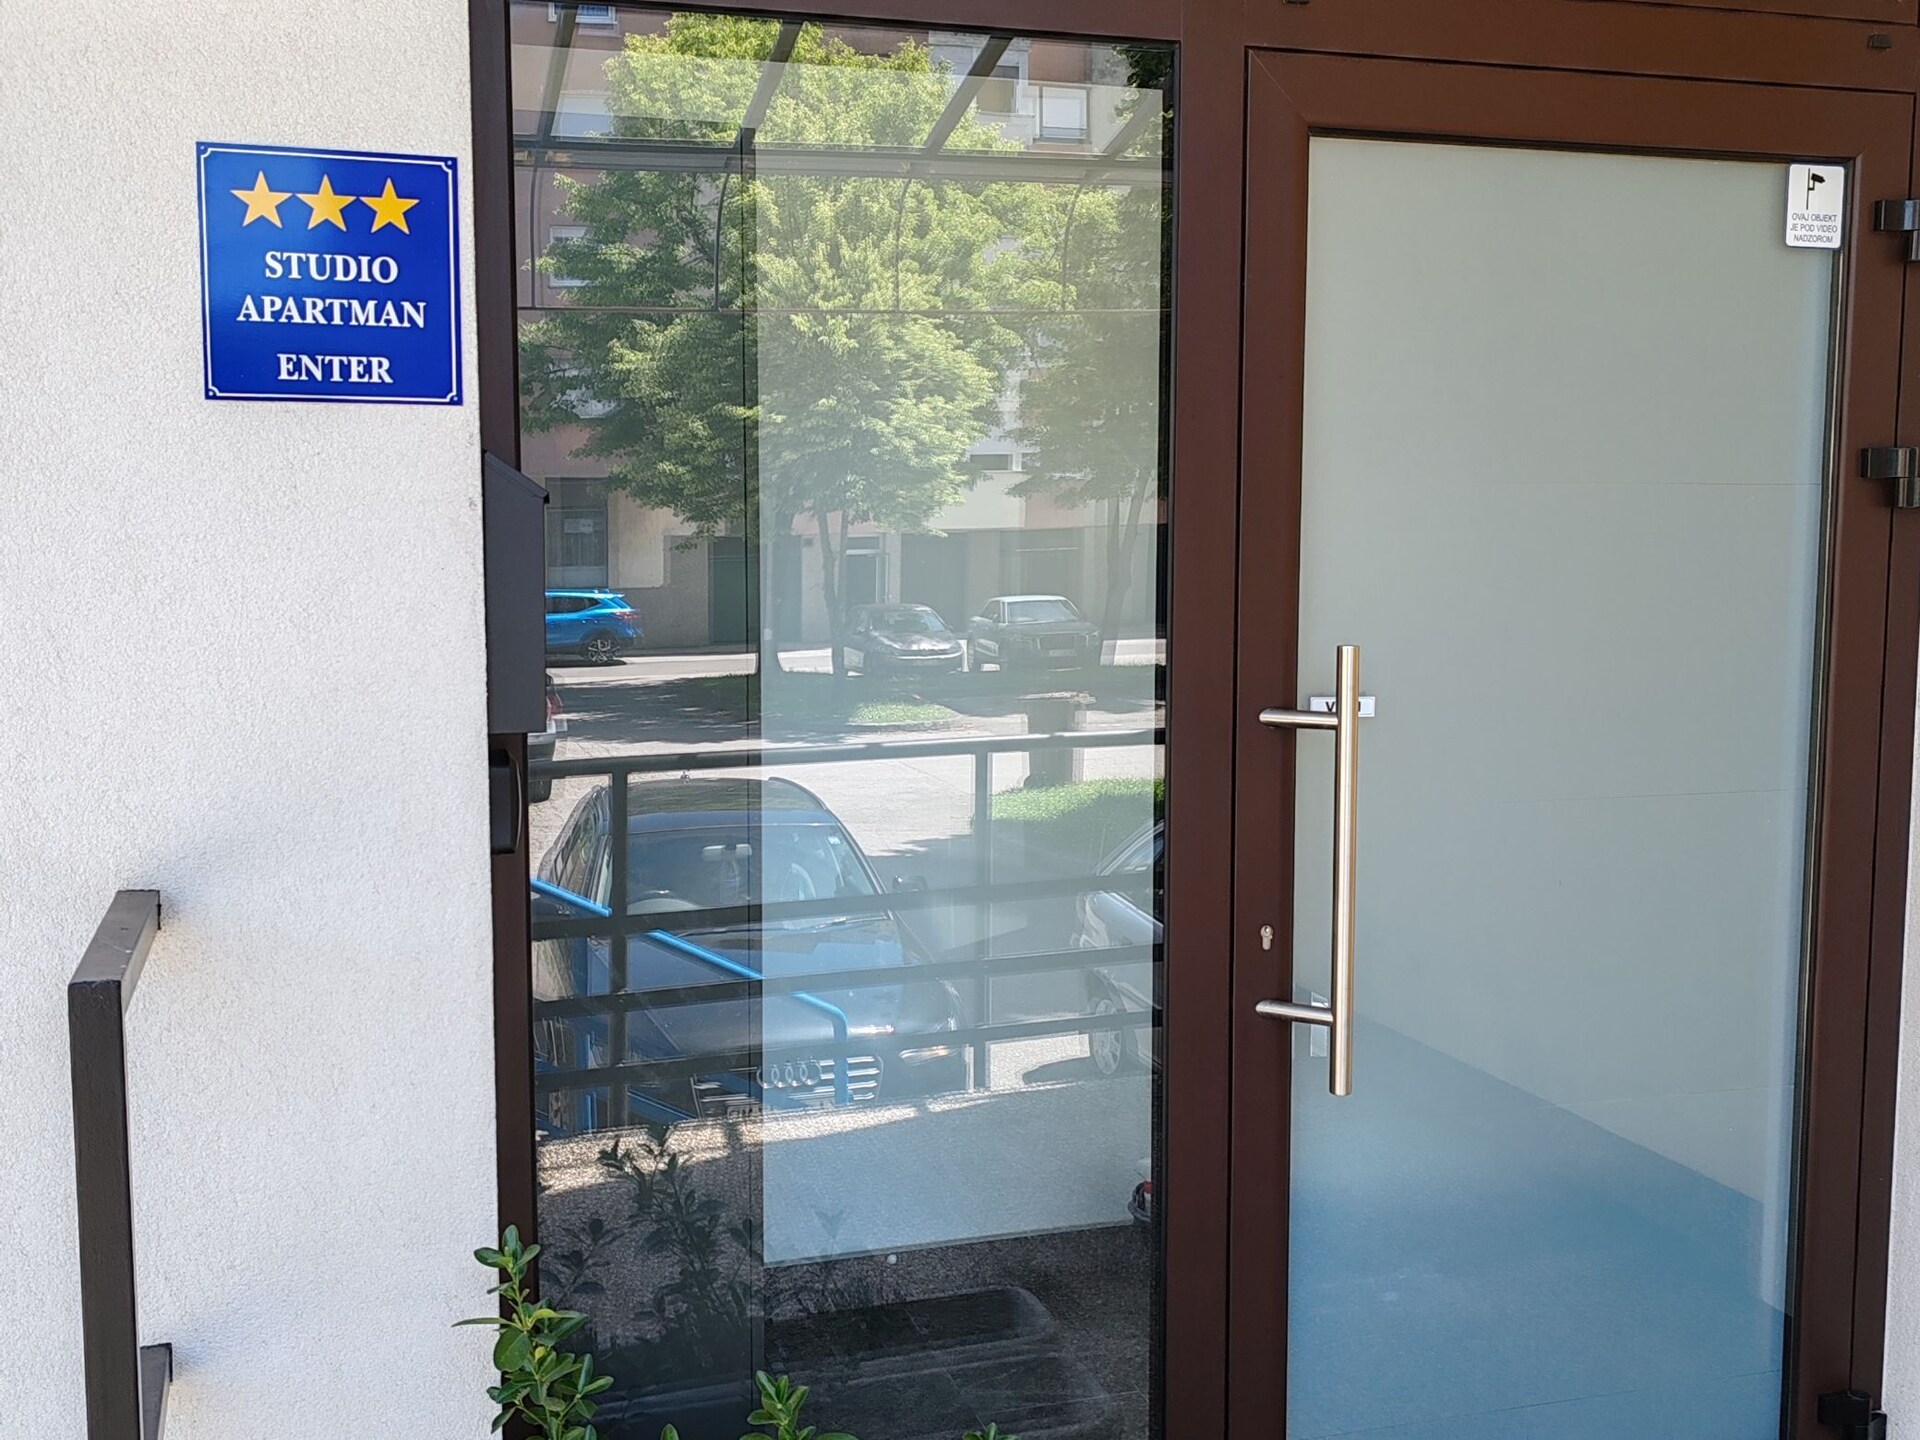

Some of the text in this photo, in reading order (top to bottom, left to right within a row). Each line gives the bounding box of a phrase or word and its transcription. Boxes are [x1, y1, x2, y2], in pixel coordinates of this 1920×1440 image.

[1790, 223, 1838, 233] JE POD VIDEO
[1791, 213, 1837, 223] OVAJ OBJEKT
[1793, 234, 1834, 243] NADZOROM
[265, 251, 399, 283] STUDIO
[236, 294, 427, 328] APARTMAN
[276, 353, 394, 383] ENTER
